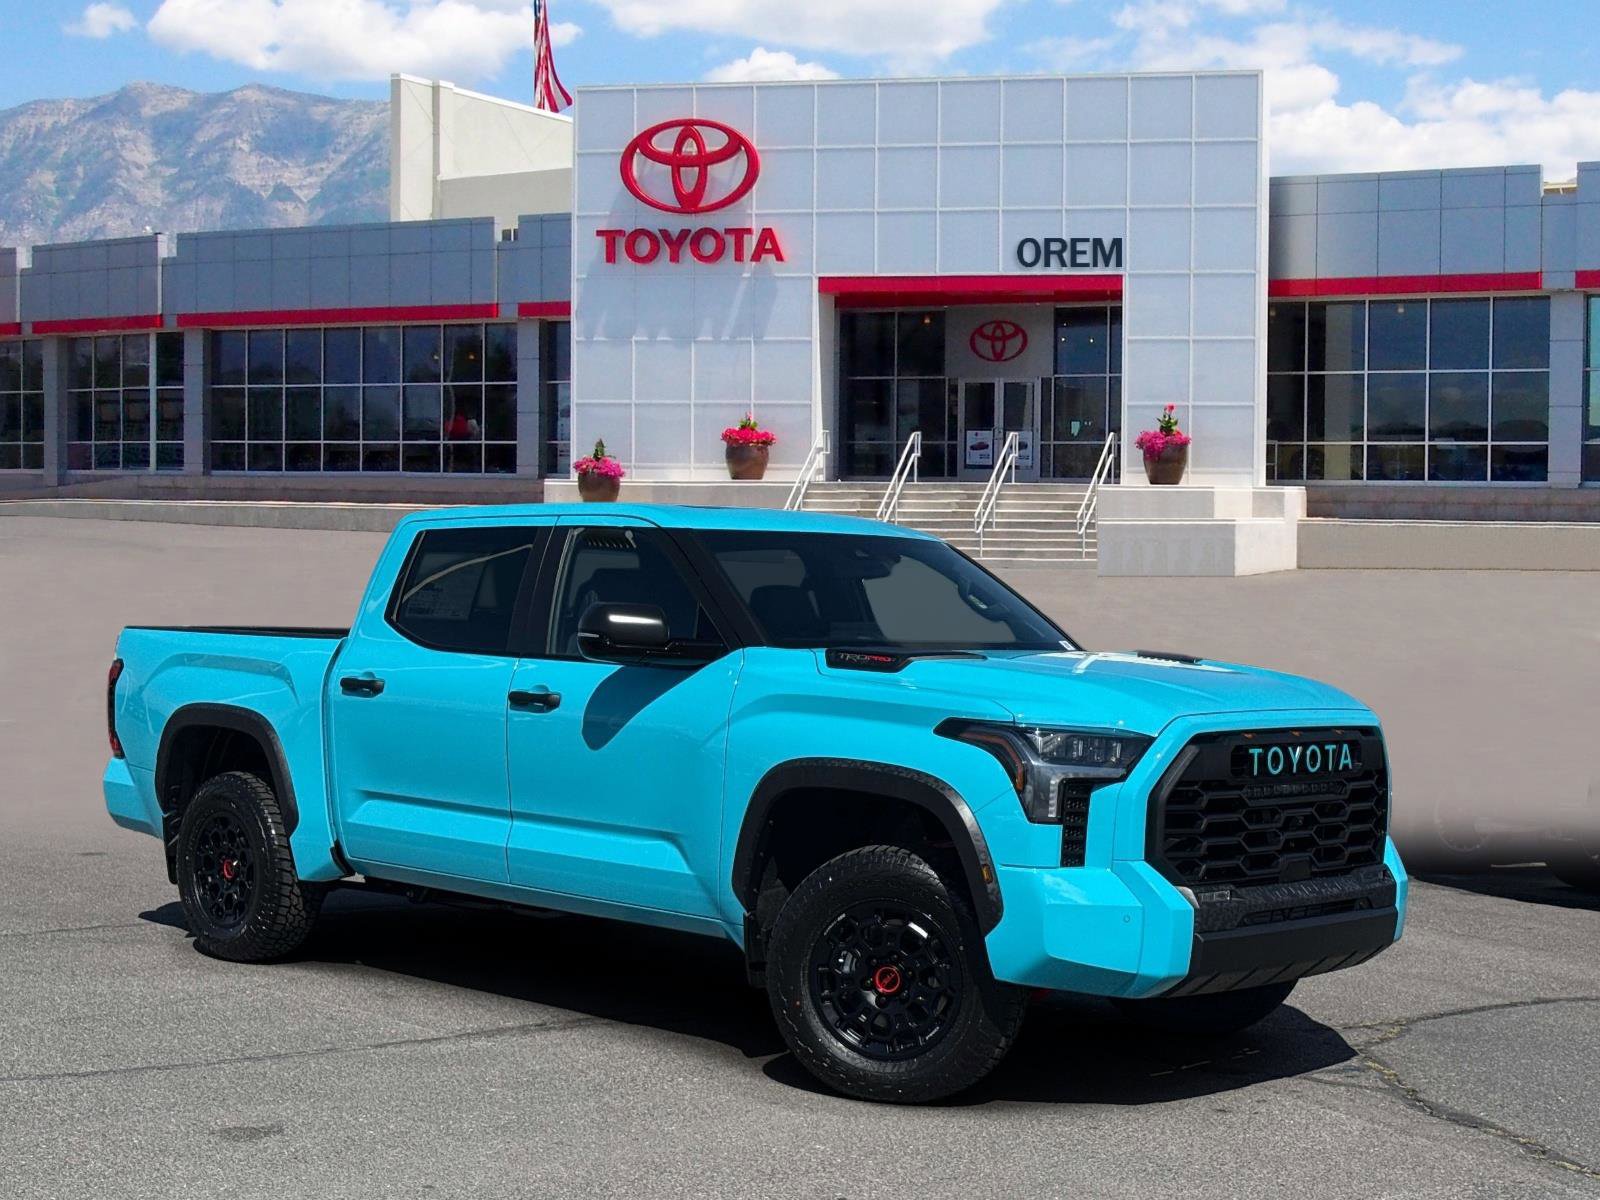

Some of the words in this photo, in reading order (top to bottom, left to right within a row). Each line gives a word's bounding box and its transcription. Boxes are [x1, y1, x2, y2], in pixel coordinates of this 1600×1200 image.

[596, 227, 784, 264] TOYOTA
[1017, 237, 1122, 268] OREM
[1248, 743, 1353, 776] TOYOTA
